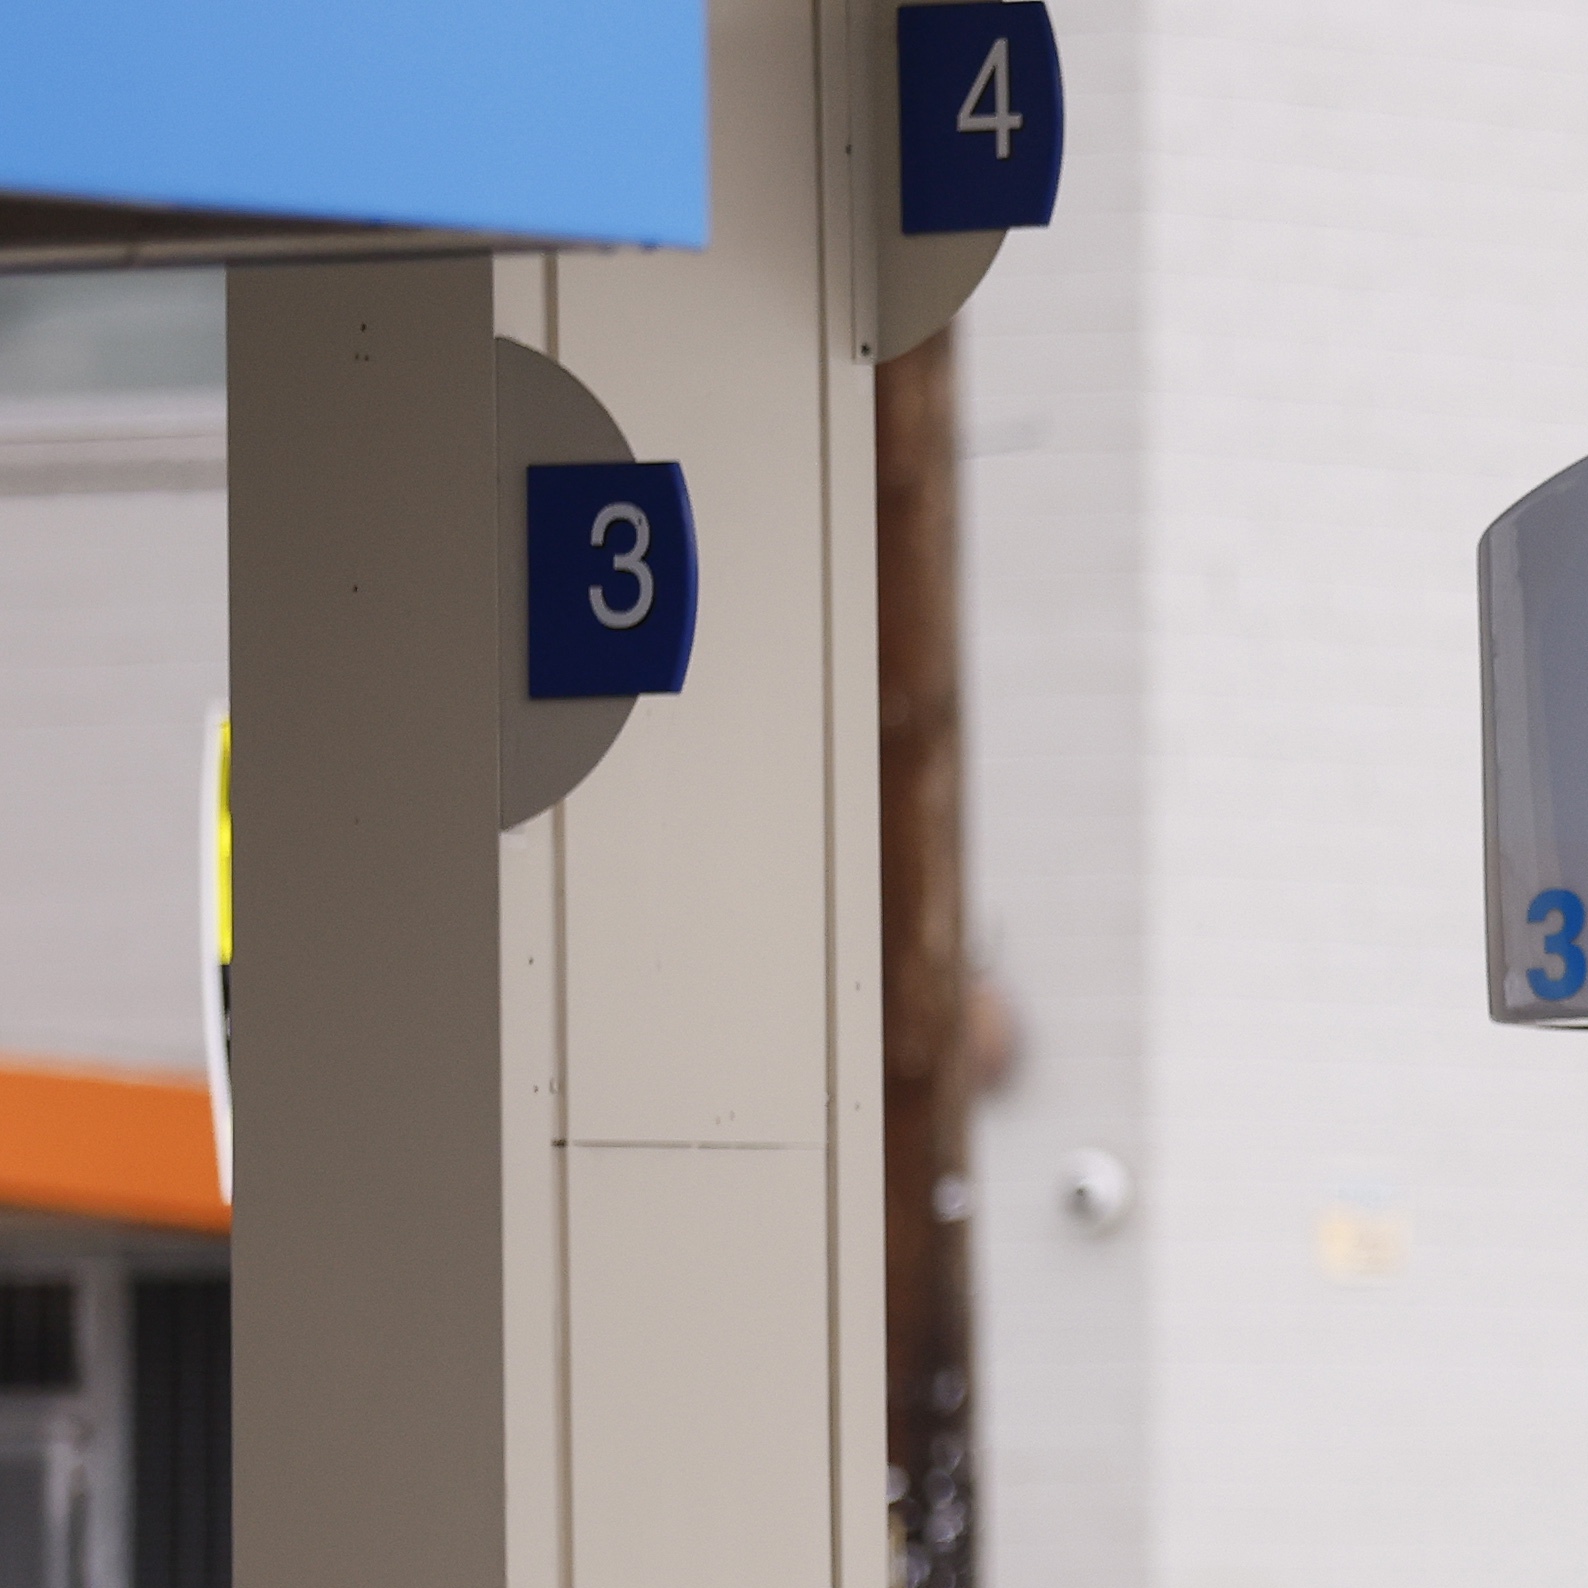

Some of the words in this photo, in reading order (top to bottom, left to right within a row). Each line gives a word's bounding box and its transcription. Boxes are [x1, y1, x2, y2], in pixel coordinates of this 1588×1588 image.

[956, 38, 1022, 158] 4
[588, 501, 654, 628] 3
[1526, 888, 1587, 1001] 3
